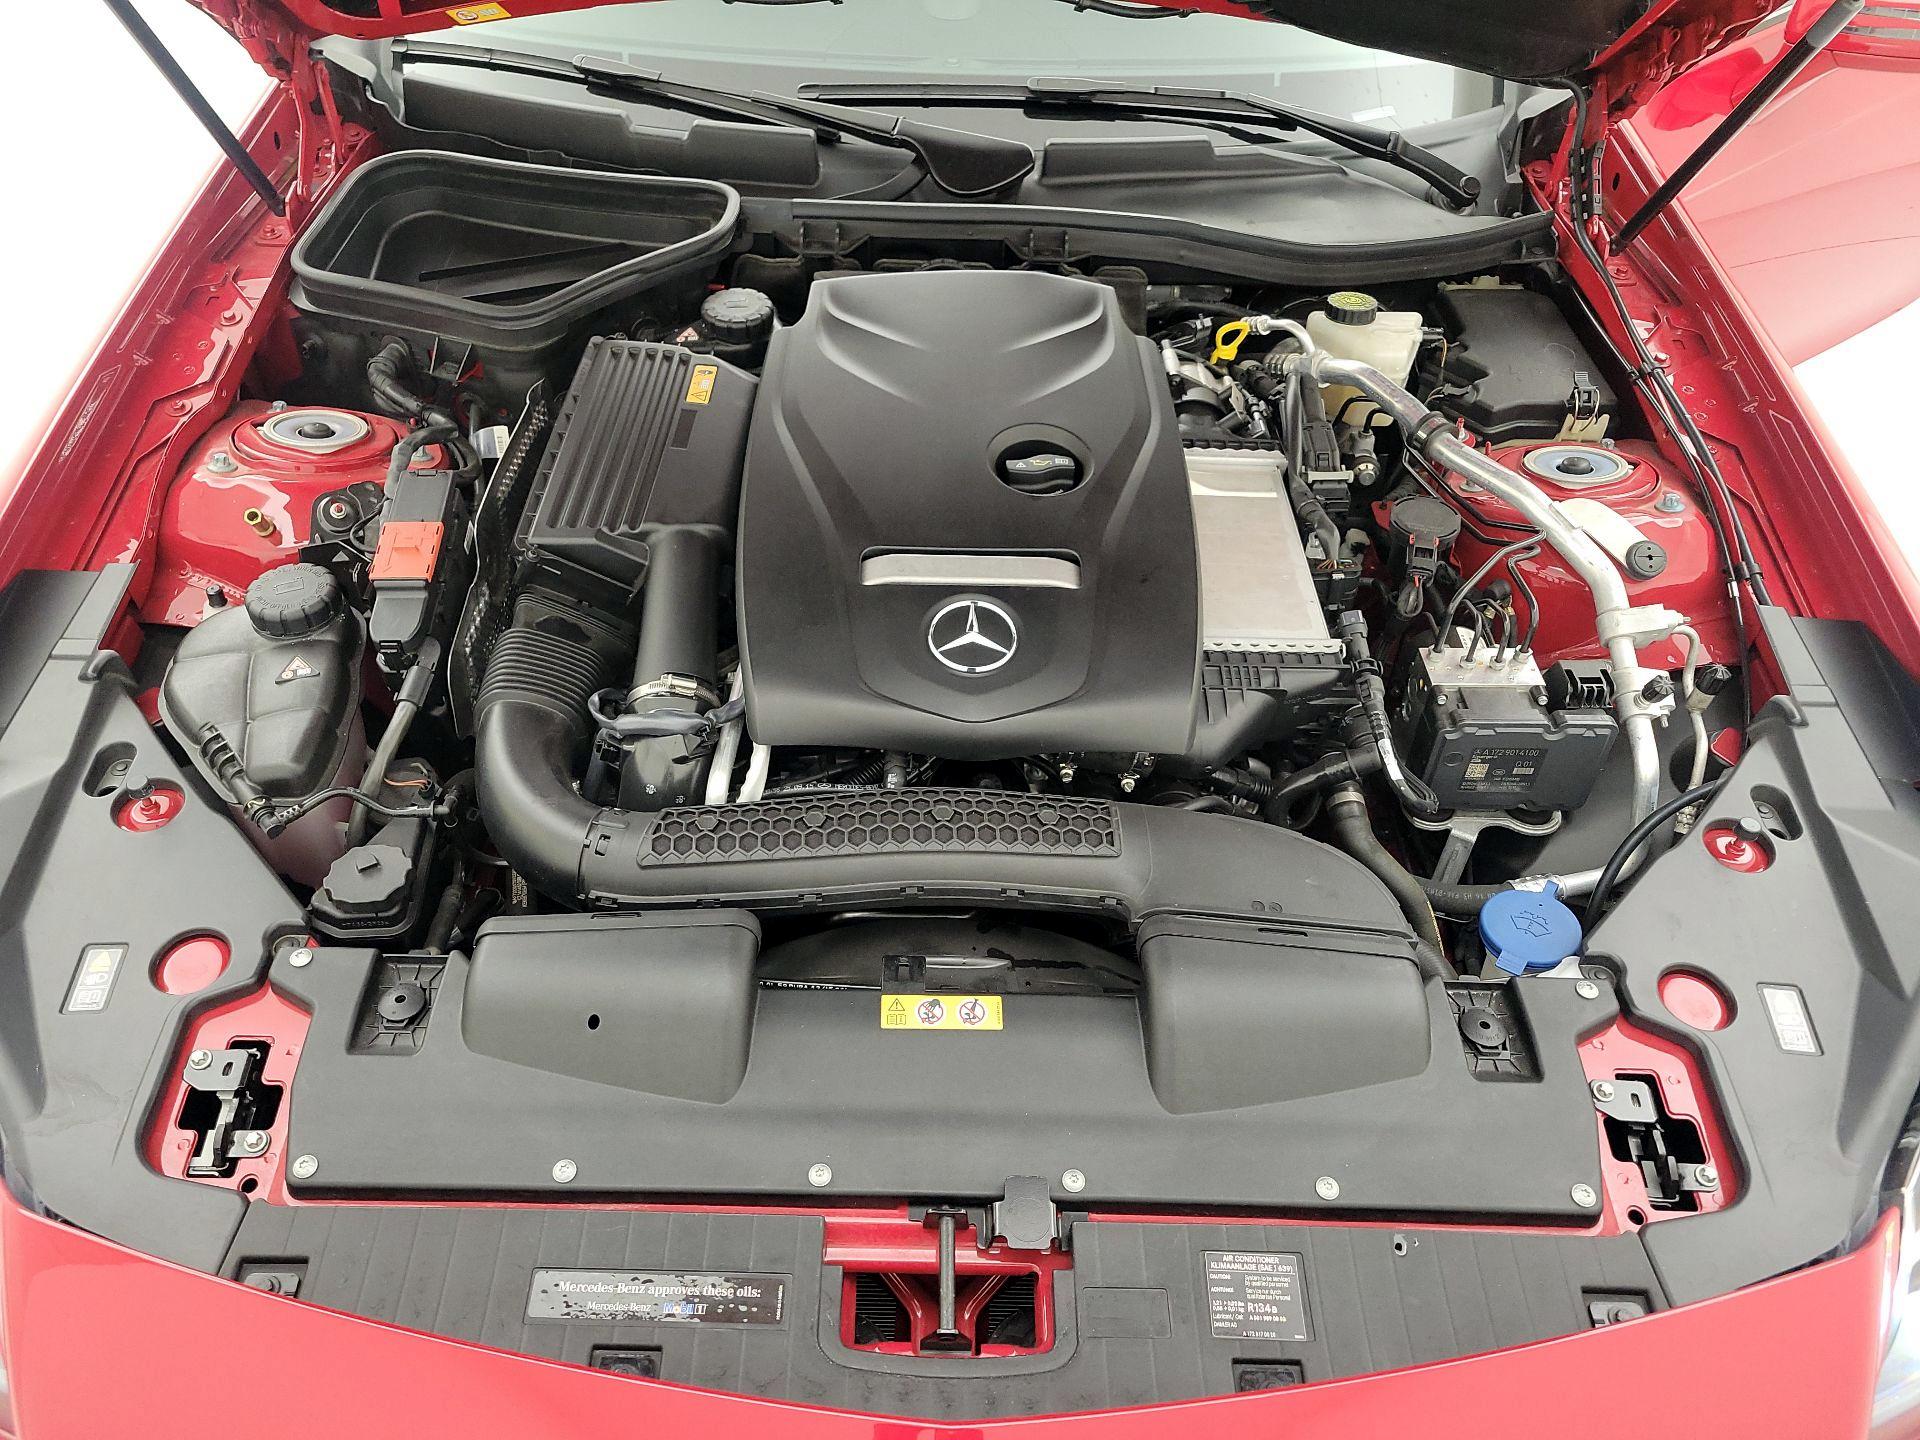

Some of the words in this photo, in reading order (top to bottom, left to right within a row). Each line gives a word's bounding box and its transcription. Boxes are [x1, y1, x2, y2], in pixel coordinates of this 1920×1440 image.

[1222, 1254, 1234, 1262] AIR
[1234, 1255, 1280, 1264] CONDITIONER
[1210, 1261, 1257, 1271] KLIMAANLAGE
[558, 1280, 646, 1295] Mercedes-Benz
[647, 1284, 700, 1300] approves
[702, 1284, 734, 1298] these
[736, 1286, 762, 1298] oils:
[587, 1301, 651, 1313] Mercedes-Benz
[662, 1301, 695, 1314] Mobil
[1247, 1302, 1278, 1314] R134a
